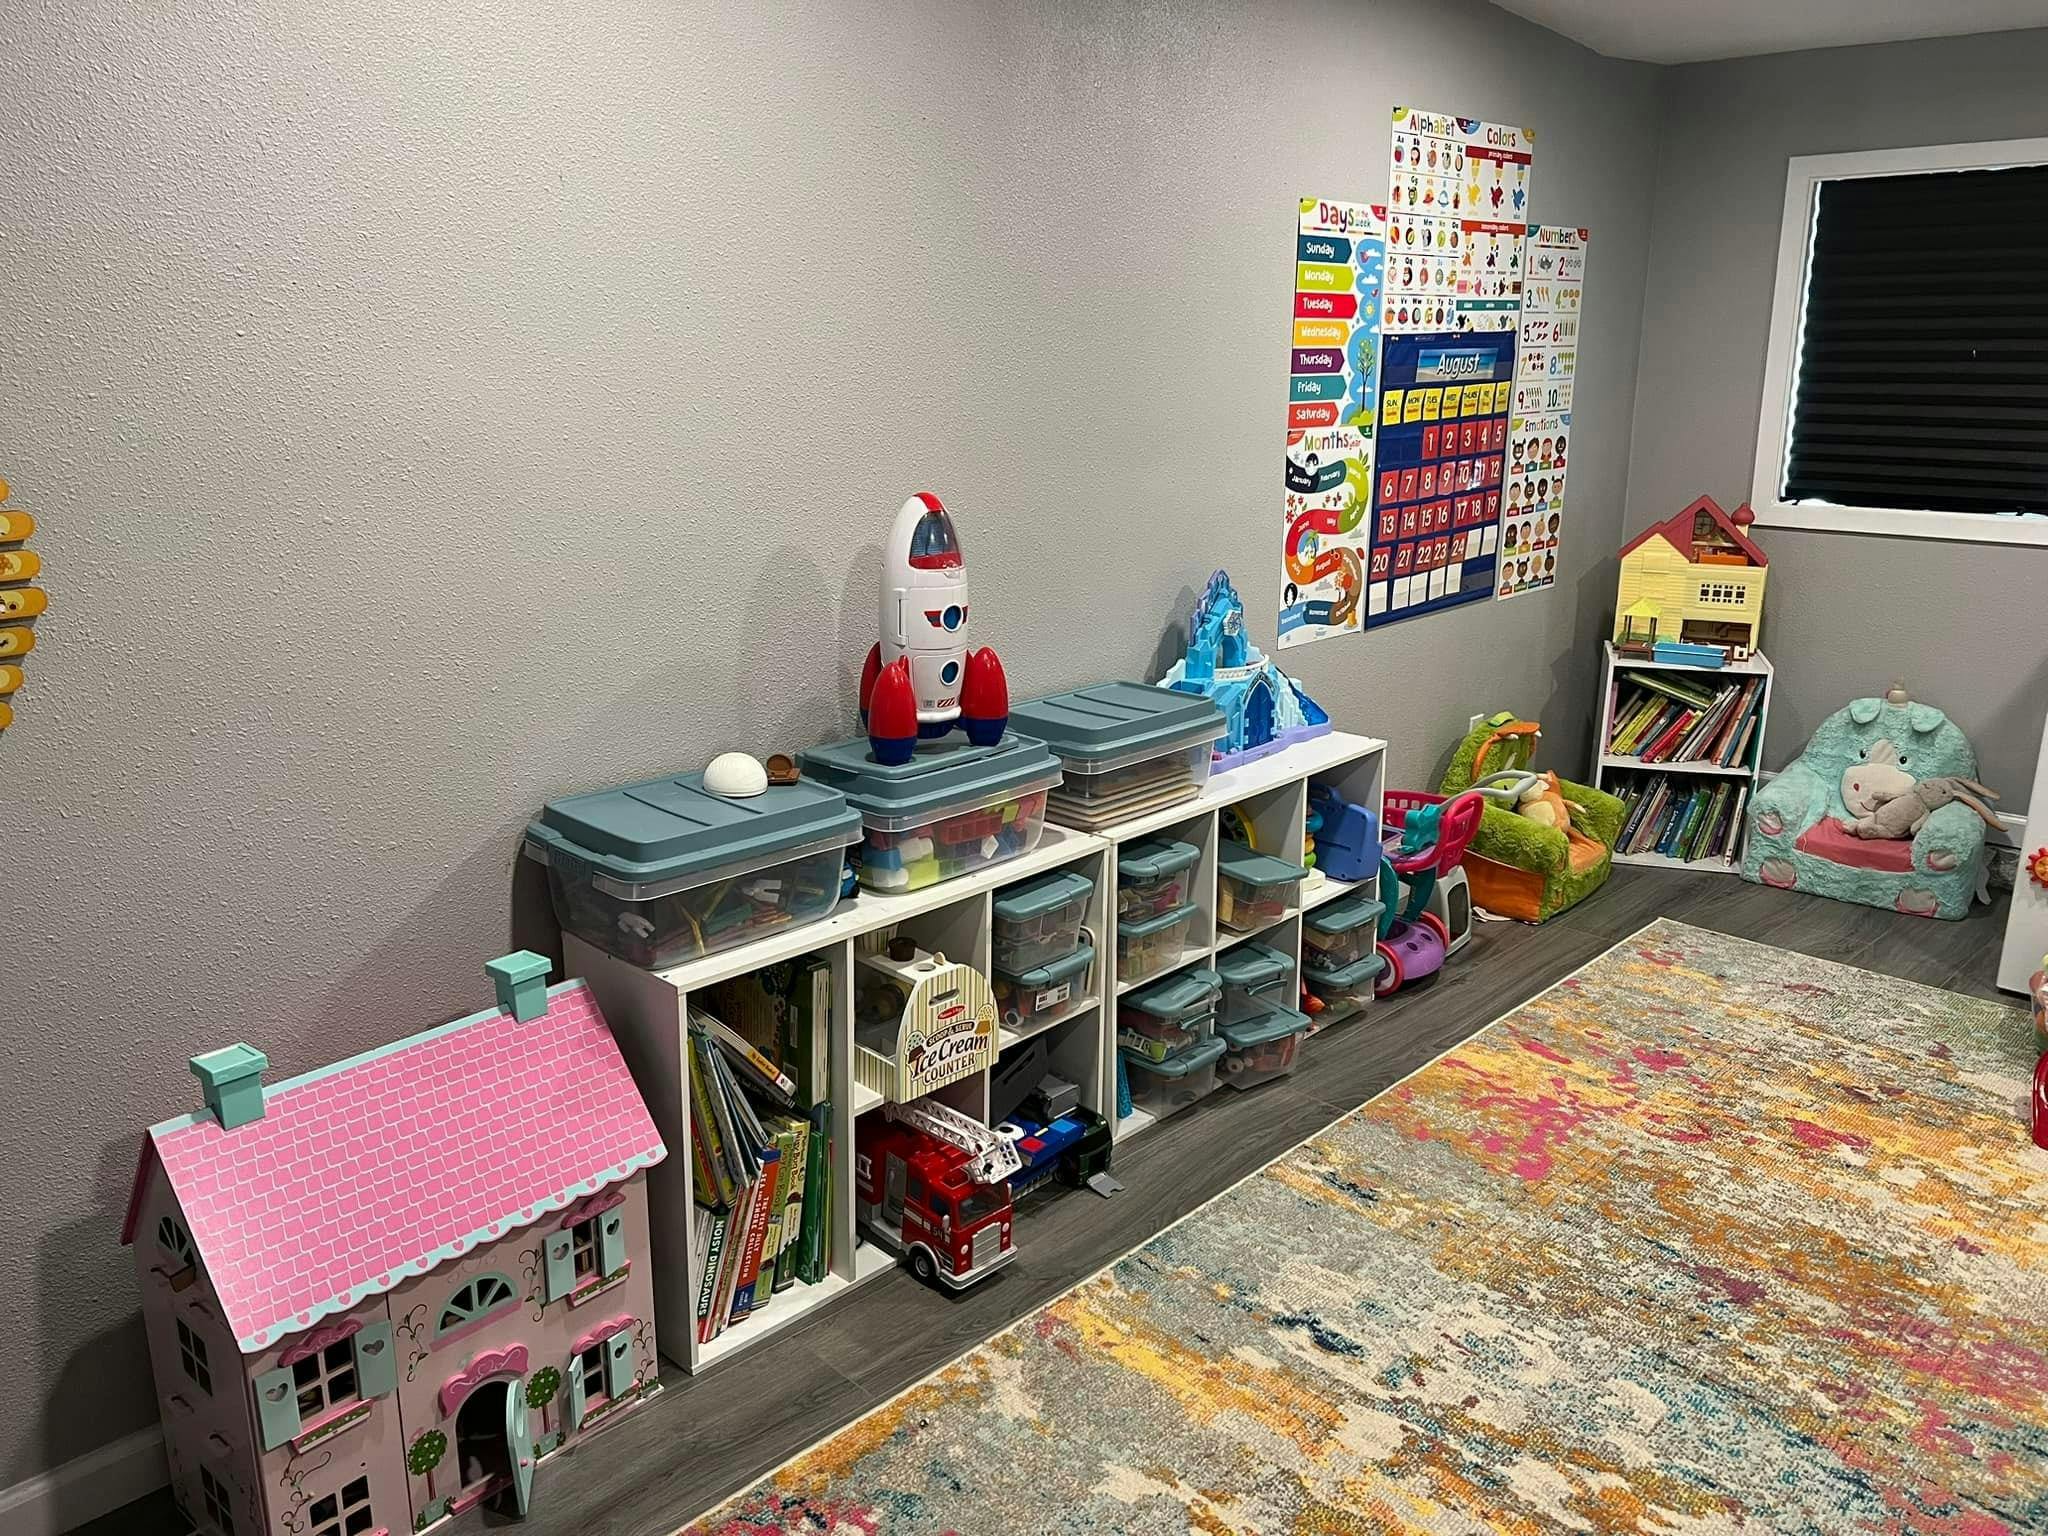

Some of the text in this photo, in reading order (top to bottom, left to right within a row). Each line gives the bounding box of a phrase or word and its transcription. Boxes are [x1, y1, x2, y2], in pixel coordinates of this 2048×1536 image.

[1410, 113, 1455, 136] Alphabet
[1487, 127, 1516, 147] Colors
[1320, 202, 1354, 233] Days
[1540, 228, 1577, 245] Numbers
[1306, 242, 1335, 258] Sunday
[1558, 257, 1565, 276] 2
[1304, 269, 1335, 285] Monday
[1303, 297, 1333, 313] Tuesday
[1526, 289, 1532, 308] 3
[1556, 290, 1561, 309] 4
[1301, 324, 1341, 339] Wednesday
[1523, 324, 1530, 342] 5
[1553, 322, 1559, 342] 6
[1300, 353, 1333, 367] Thursday
[1437, 352, 1480, 379] August
[1520, 357, 1528, 376] 7
[1550, 356, 1557, 375] 8
[1297, 381, 1321, 395] Friday
[1518, 391, 1524, 409] 9
[1547, 388, 1558, 408] 10
[1296, 409, 1331, 421] Saturday
[1525, 418, 1559, 432] Emotions
[1304, 431, 1349, 452] Months
[1428, 425, 1502, 451] 1 2 3 4 5
[1291, 475, 1312, 487] January
[1320, 470, 1340, 481] February
[1384, 479, 1393, 497] 6
[1405, 475, 1413, 493] 7
[1424, 472, 1431, 490] 8
[1443, 470, 1451, 487] 9
[1459, 466, 1469, 484] 10
[1490, 461, 1499, 478] 12
[1382, 496, 1497, 534] 13 14 15 16 17 18 19
[1372, 538, 1465, 573] 20 21 22 23 24
[912, 1035, 988, 1078] Ice Cream
[924, 1054, 975, 1083] COUNTER
[760, 1173, 768, 1189] SEA
[742, 1233, 755, 1279] COLLECTION
[698, 1220, 725, 1316] NOISY DINOSAURS
